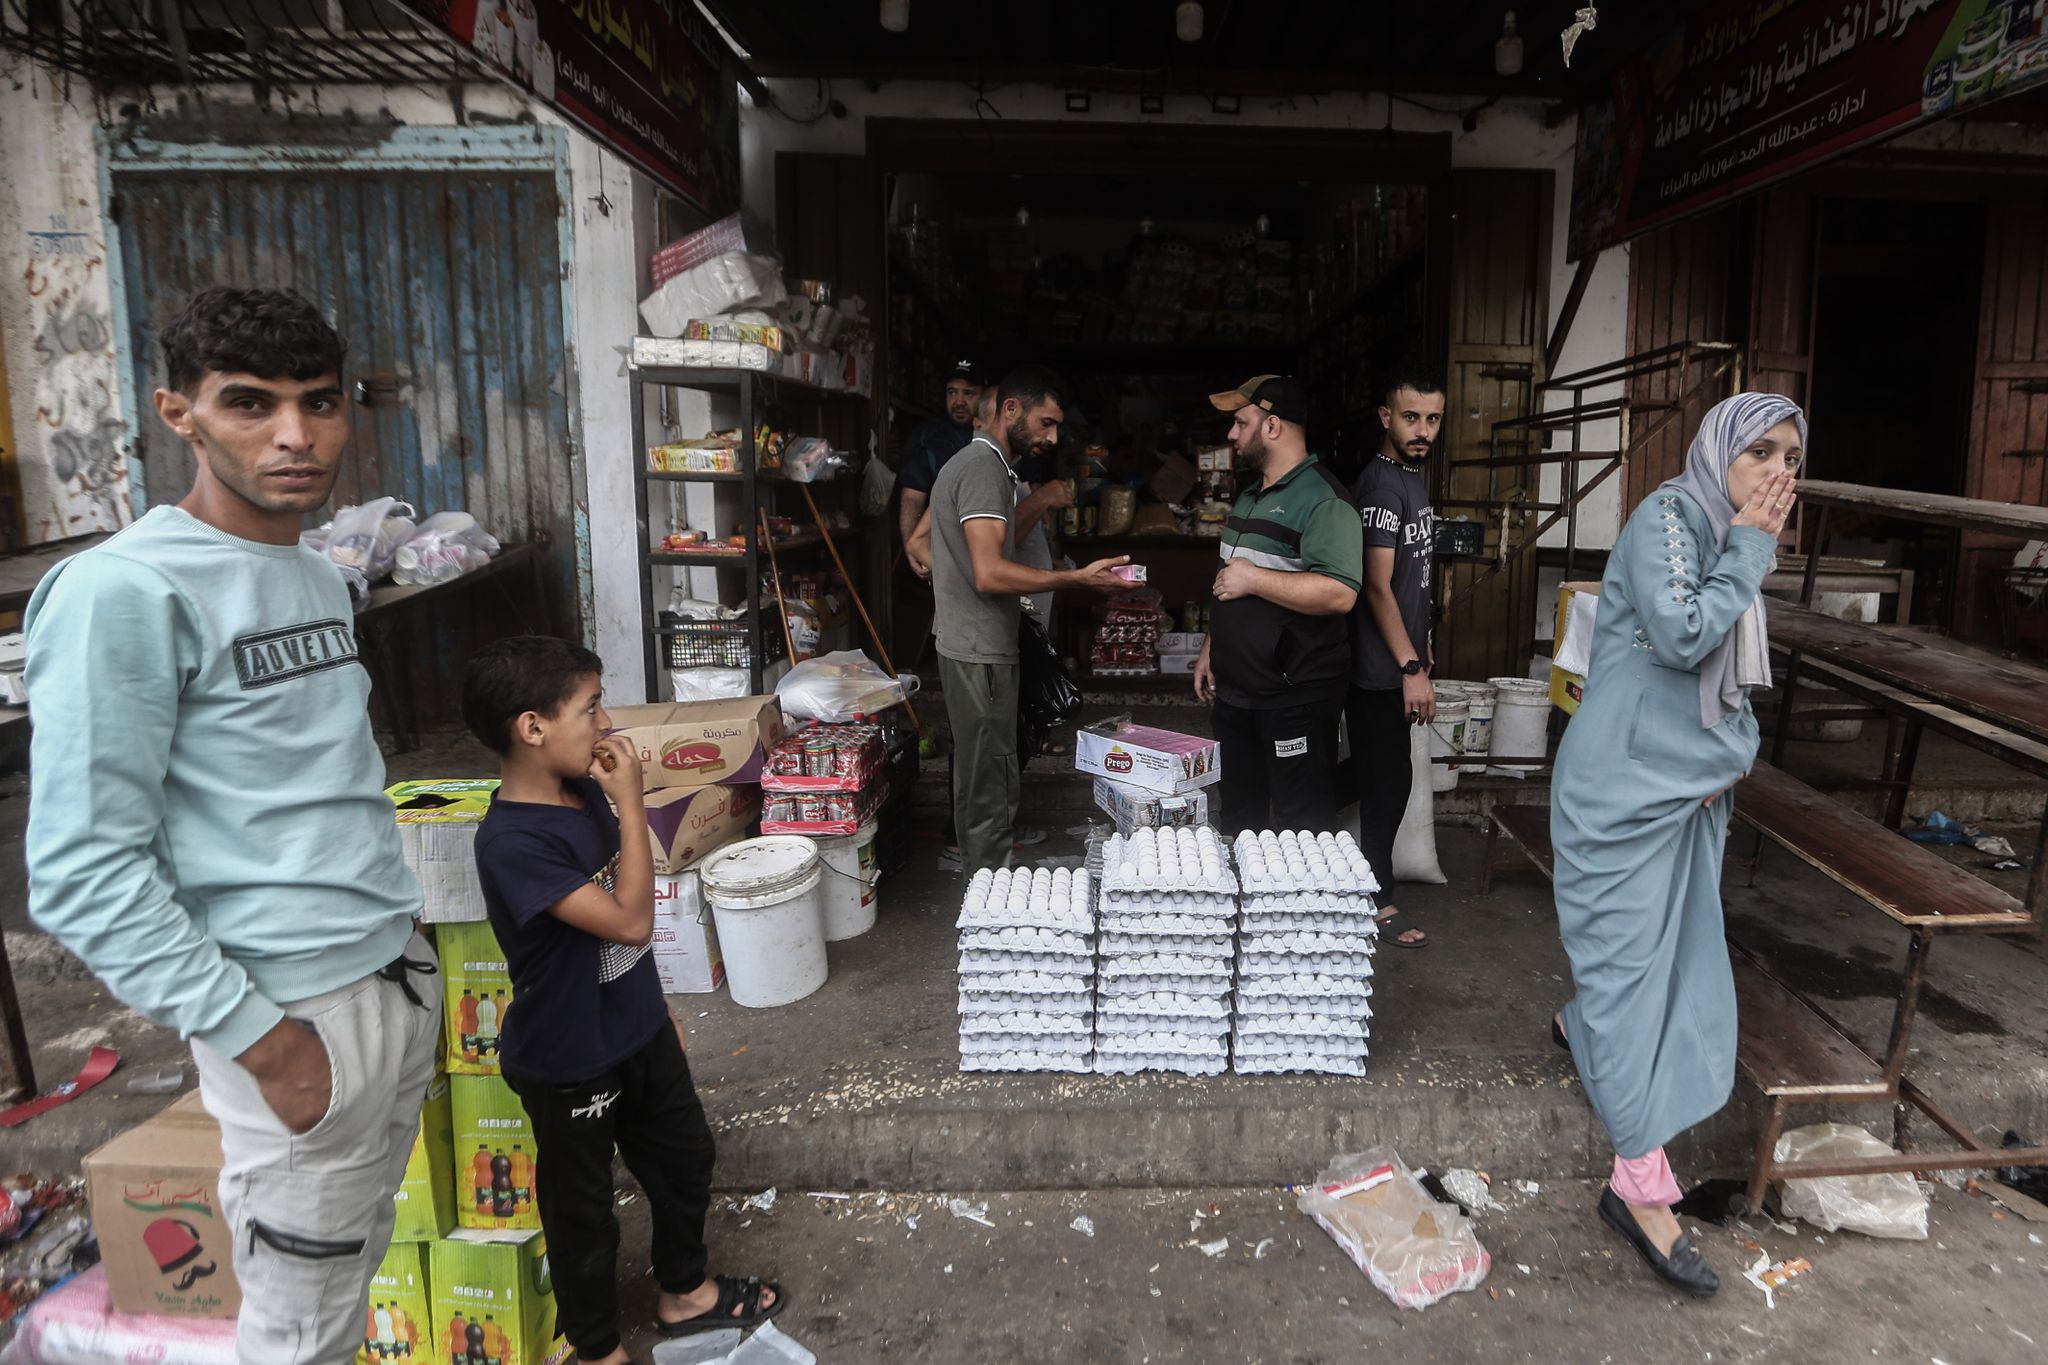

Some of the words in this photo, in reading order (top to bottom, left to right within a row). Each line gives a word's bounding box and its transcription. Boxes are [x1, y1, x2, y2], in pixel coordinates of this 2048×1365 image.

[1775, 0, 1870, 94] الغذائية
[1700, 60, 1773, 134] والتجارة
[1828, 88, 1866, 124] ادارة
[1655, 97, 1700, 149] العامة
[1768, 118, 1819, 150] عبدالله
[703, 727, 742, 741] مكرونة
[667, 751, 716, 767] حواء
[1107, 757, 1130, 770] Prego
[690, 798, 725, 829] فرن
